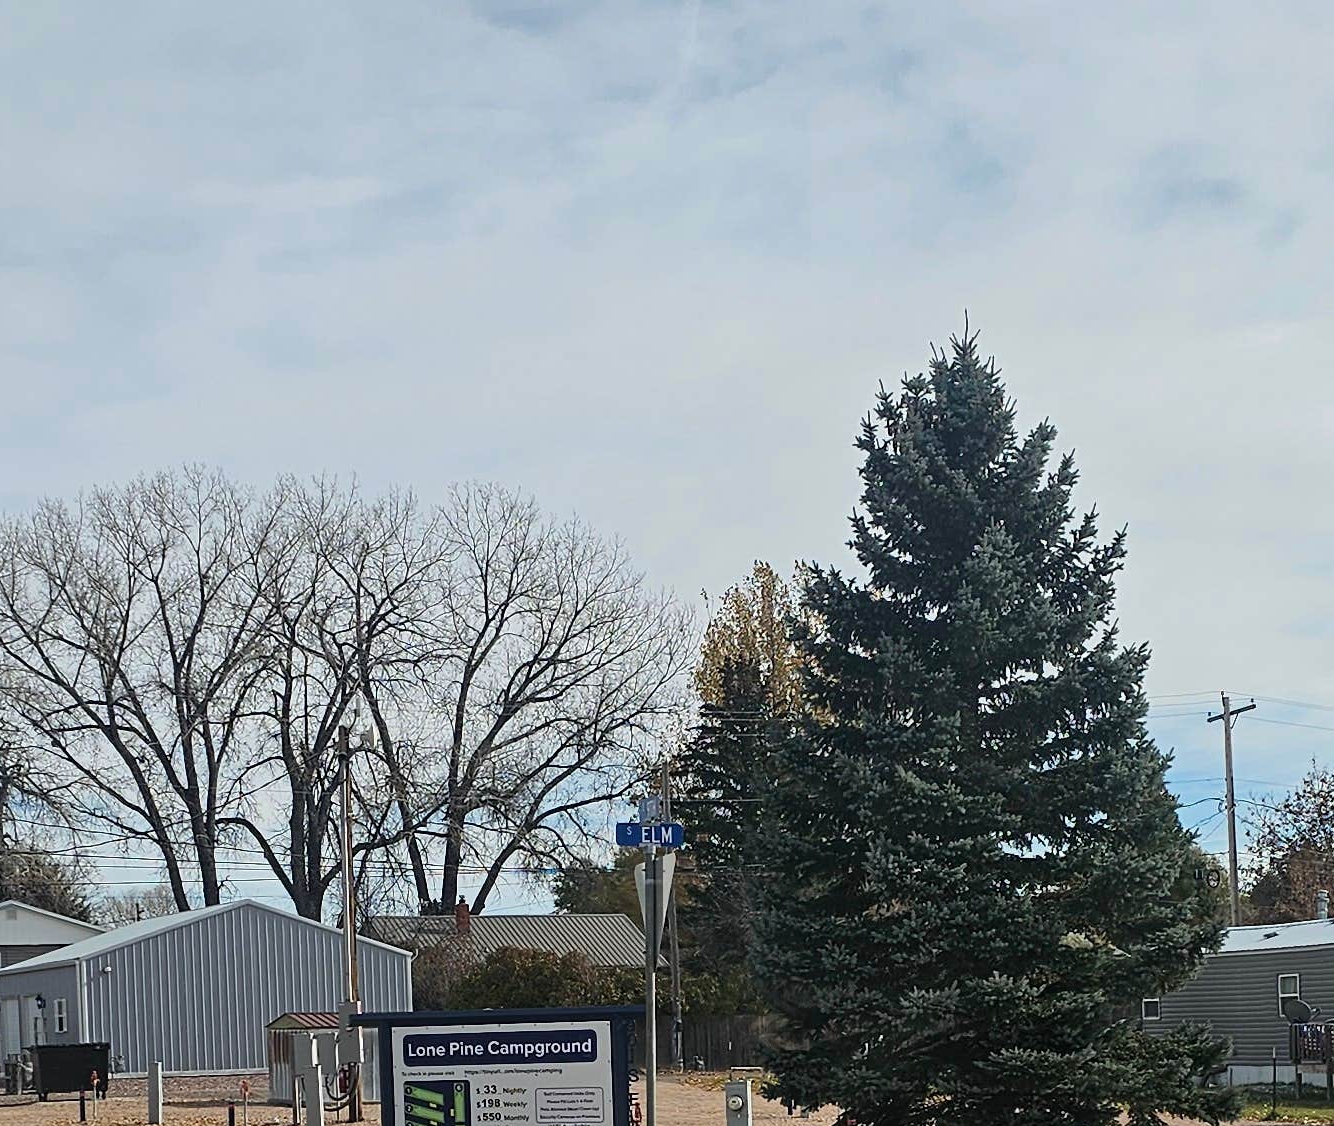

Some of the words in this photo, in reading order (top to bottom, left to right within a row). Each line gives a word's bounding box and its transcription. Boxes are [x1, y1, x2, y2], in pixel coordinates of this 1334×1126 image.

[627, 826, 633, 835] S
[641, 826, 673, 843] ELM
[408, 1043, 445, 1057] Lone
[449, 1041, 484, 1056] Pine
[487, 1038, 592, 1057] Campground
[484, 1085, 497, 1094] 33
